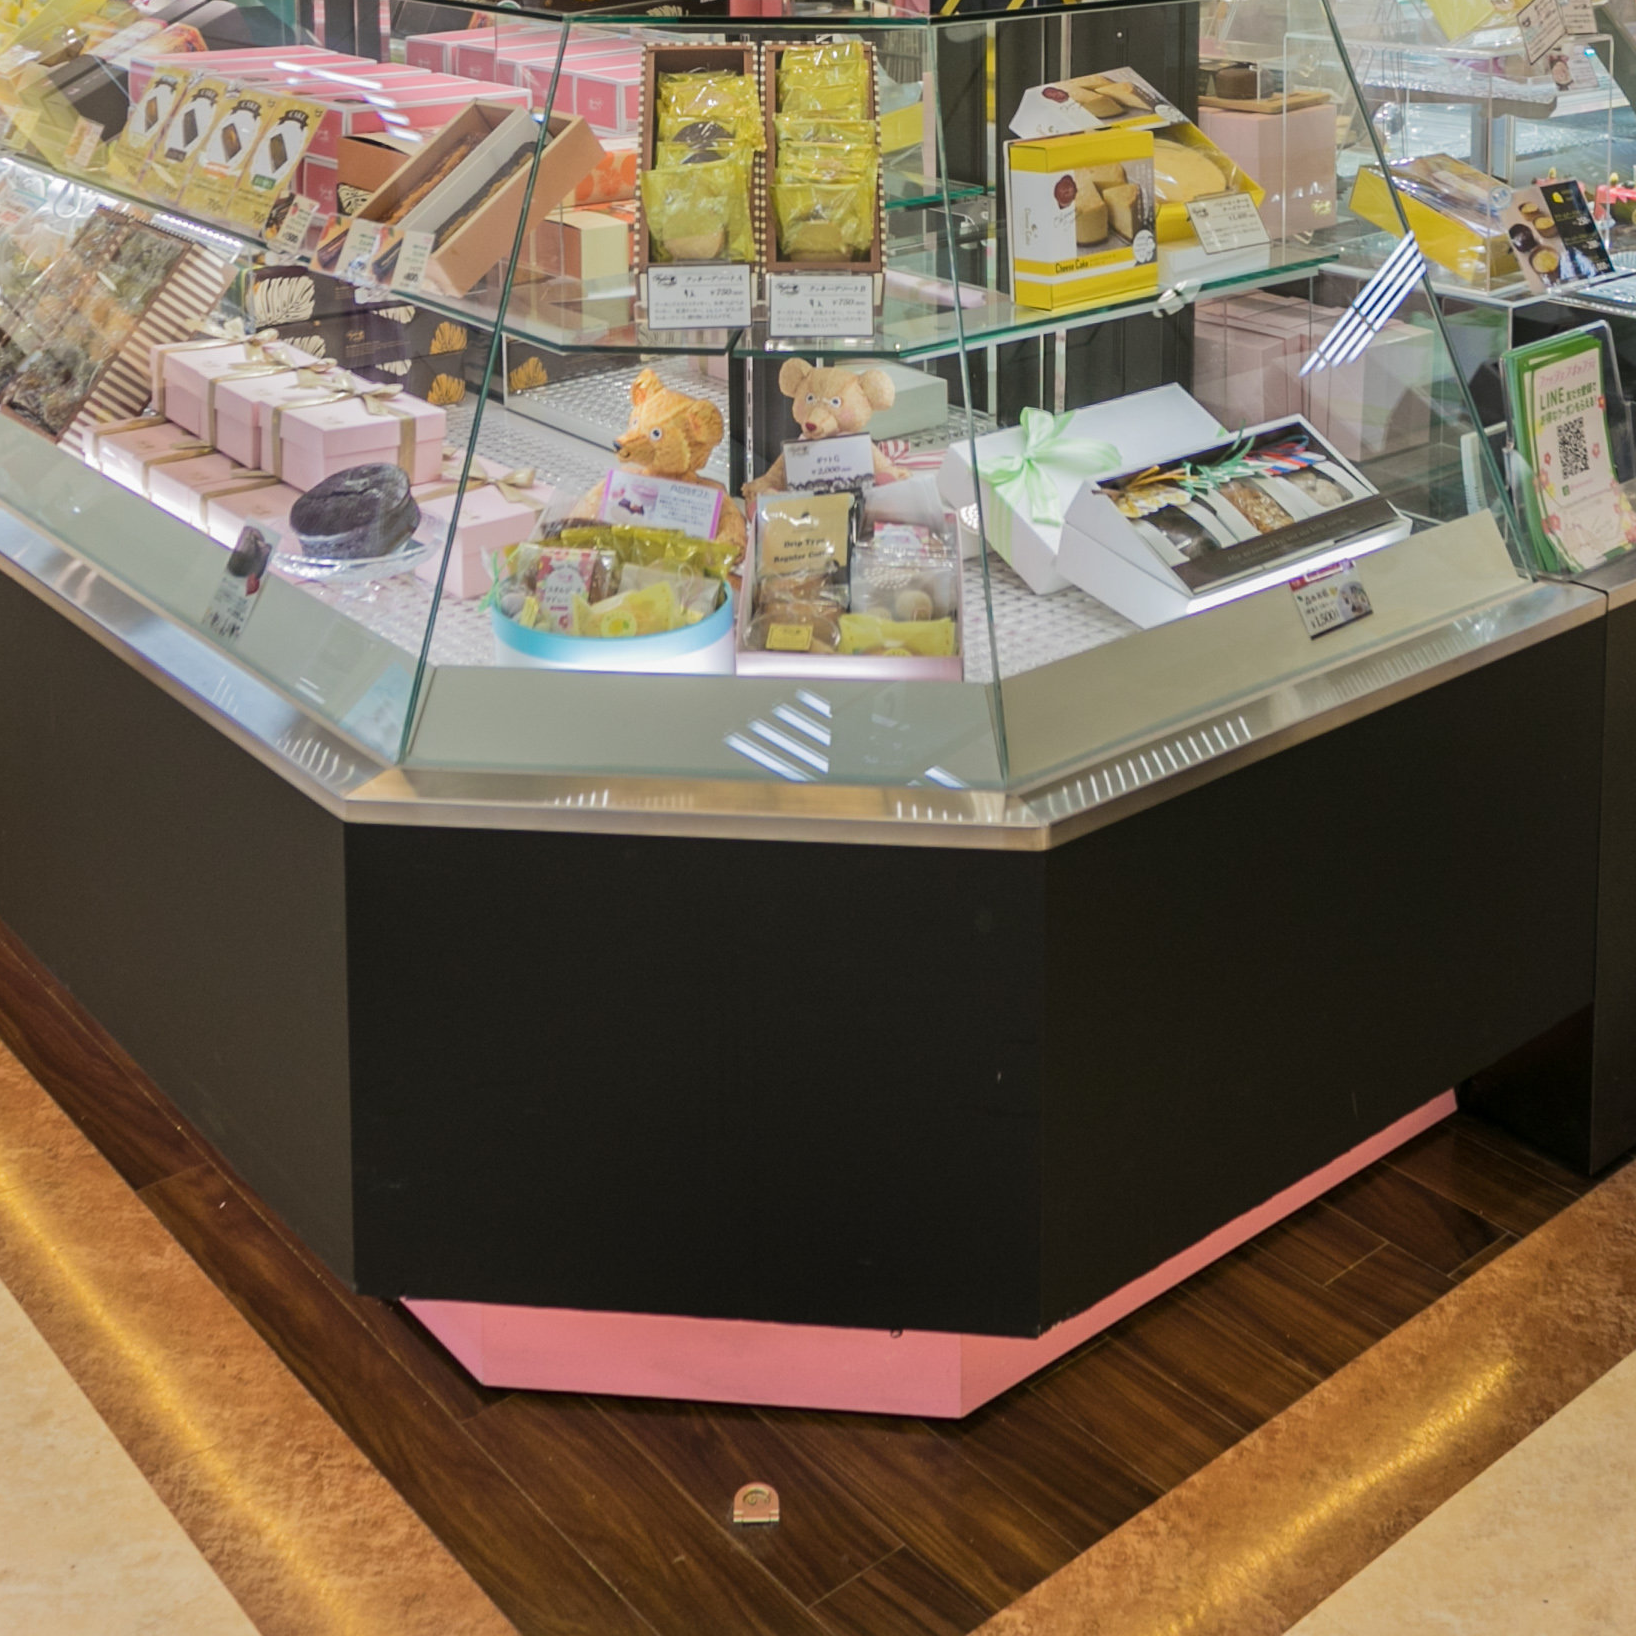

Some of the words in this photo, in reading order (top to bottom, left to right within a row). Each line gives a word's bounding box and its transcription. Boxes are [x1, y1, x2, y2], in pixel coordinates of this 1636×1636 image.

[1055, 260, 1075, 274] Cheese
[1075, 258, 1089, 269] Cake
[1540, 386, 1565, 411] LINE
[783, 540, 804, 549] Drip
[805, 537, 826, 548] Type
[773, 553, 807, 564] Regular
